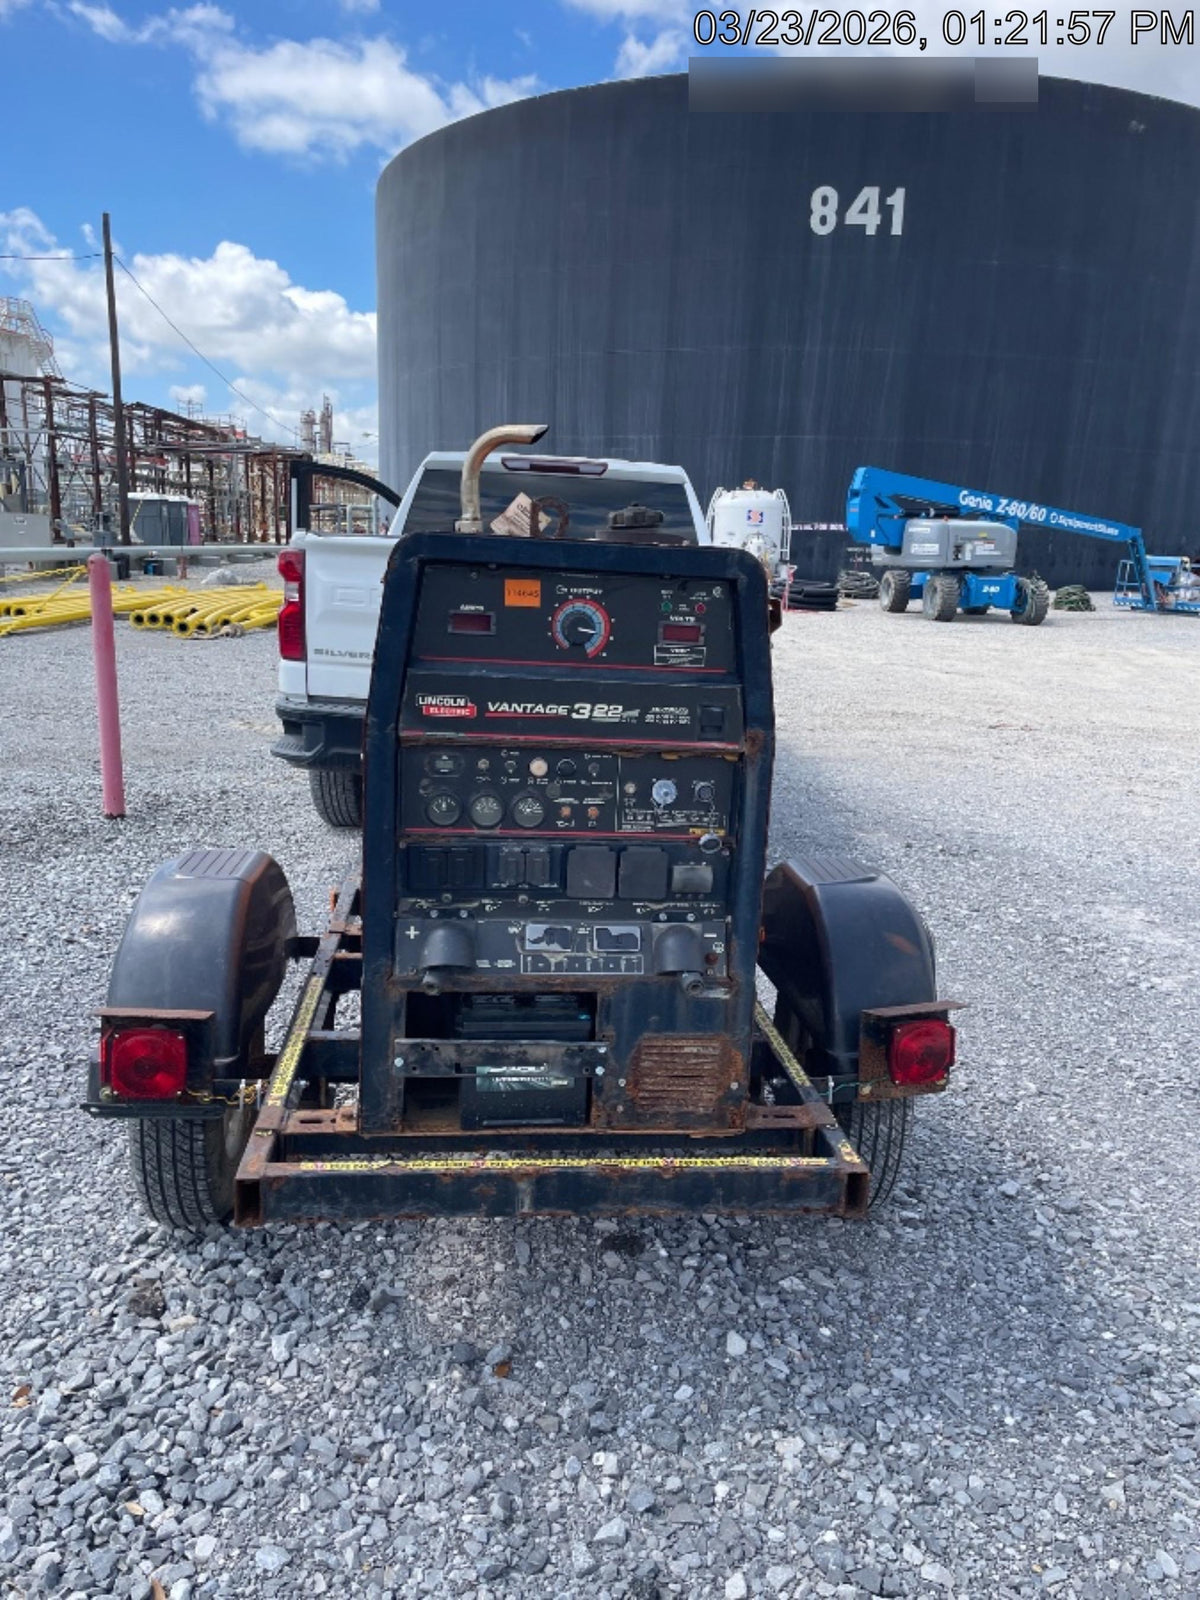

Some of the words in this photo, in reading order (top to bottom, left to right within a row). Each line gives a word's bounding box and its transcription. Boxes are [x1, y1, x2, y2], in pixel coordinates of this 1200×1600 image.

[809, 185, 907, 237] 841
[959, 490, 993, 511] Genie
[996, 498, 1046, 522] Z-80/60
[314, 648, 372, 660] SILVER
[418, 695, 466, 707] LINCOLN
[428, 706, 471, 716] ELECTRIC
[487, 700, 571, 717] VANTAGE
[571, 701, 624, 719] 322
